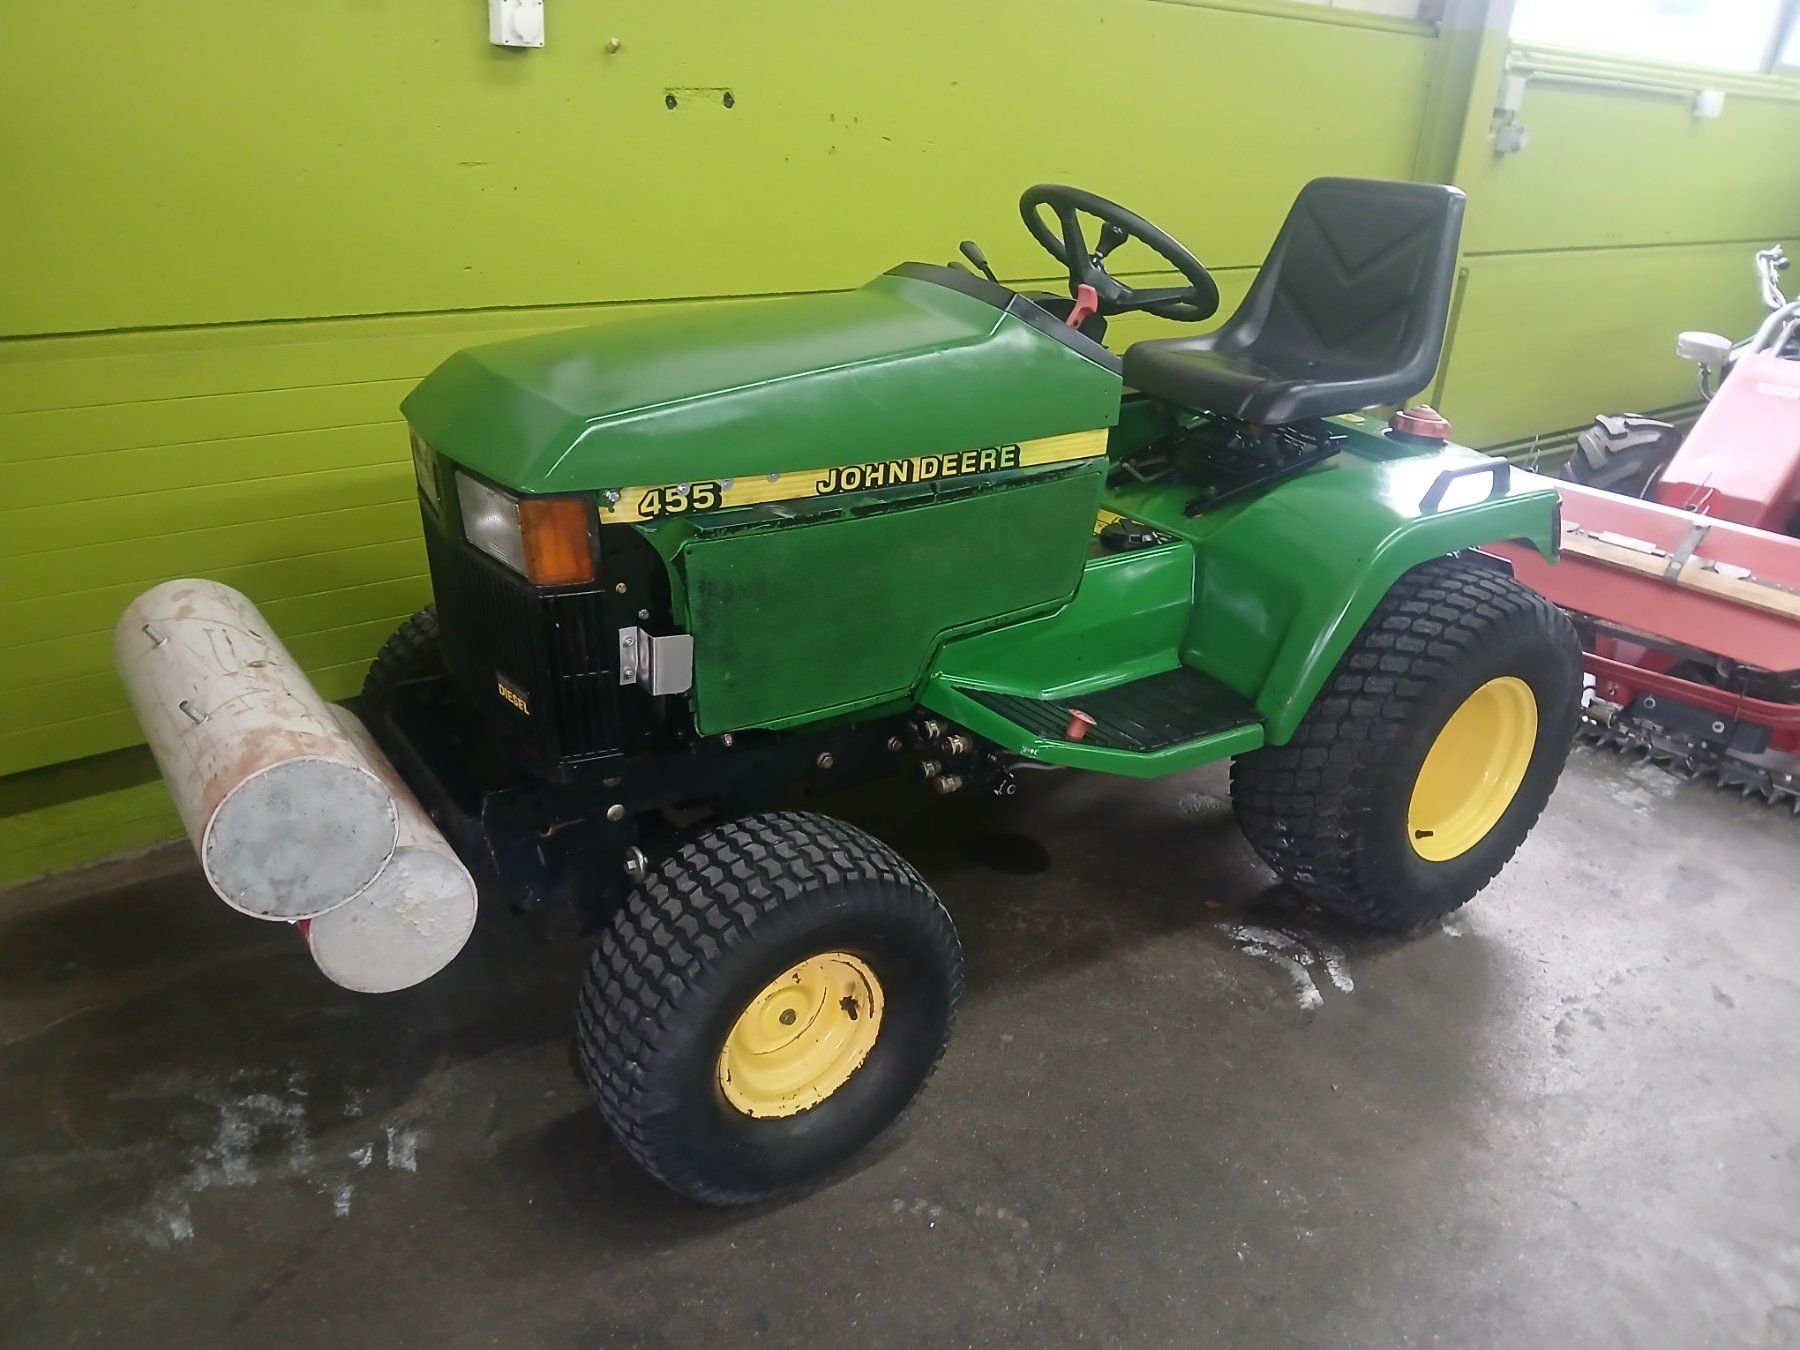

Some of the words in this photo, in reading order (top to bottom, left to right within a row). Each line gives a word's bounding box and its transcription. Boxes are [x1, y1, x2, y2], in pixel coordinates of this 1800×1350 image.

[816, 460, 912, 494] JOHN
[919, 444, 1018, 479] DEERE
[638, 483, 717, 516] 455
[497, 682, 531, 716] DIESEL
